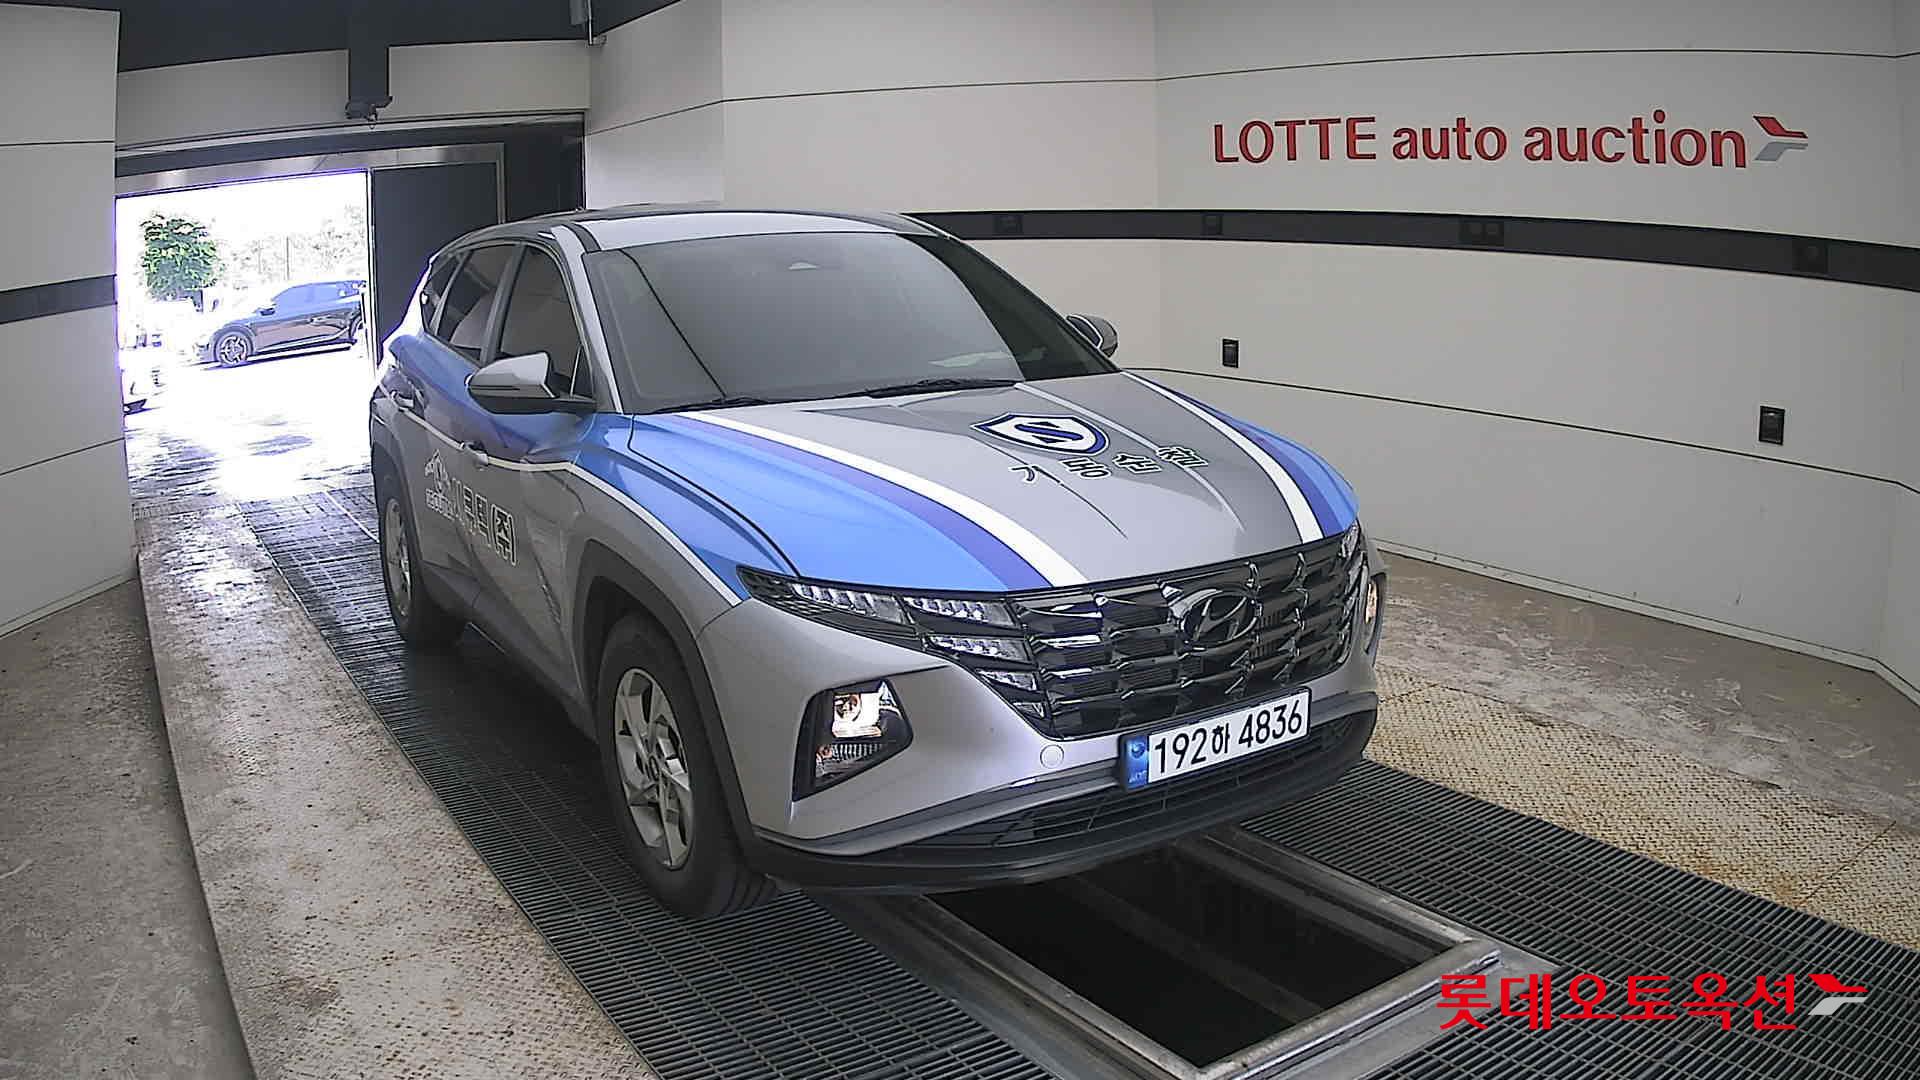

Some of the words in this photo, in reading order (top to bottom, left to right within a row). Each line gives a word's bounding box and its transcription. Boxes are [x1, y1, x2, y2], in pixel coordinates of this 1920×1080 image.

[1213, 116, 1378, 163] LOTTE
[1391, 117, 1508, 161] auto
[1523, 109, 1747, 168] auction
[1154, 722, 1231, 774] 192하
[1238, 699, 1302, 749] 4836
